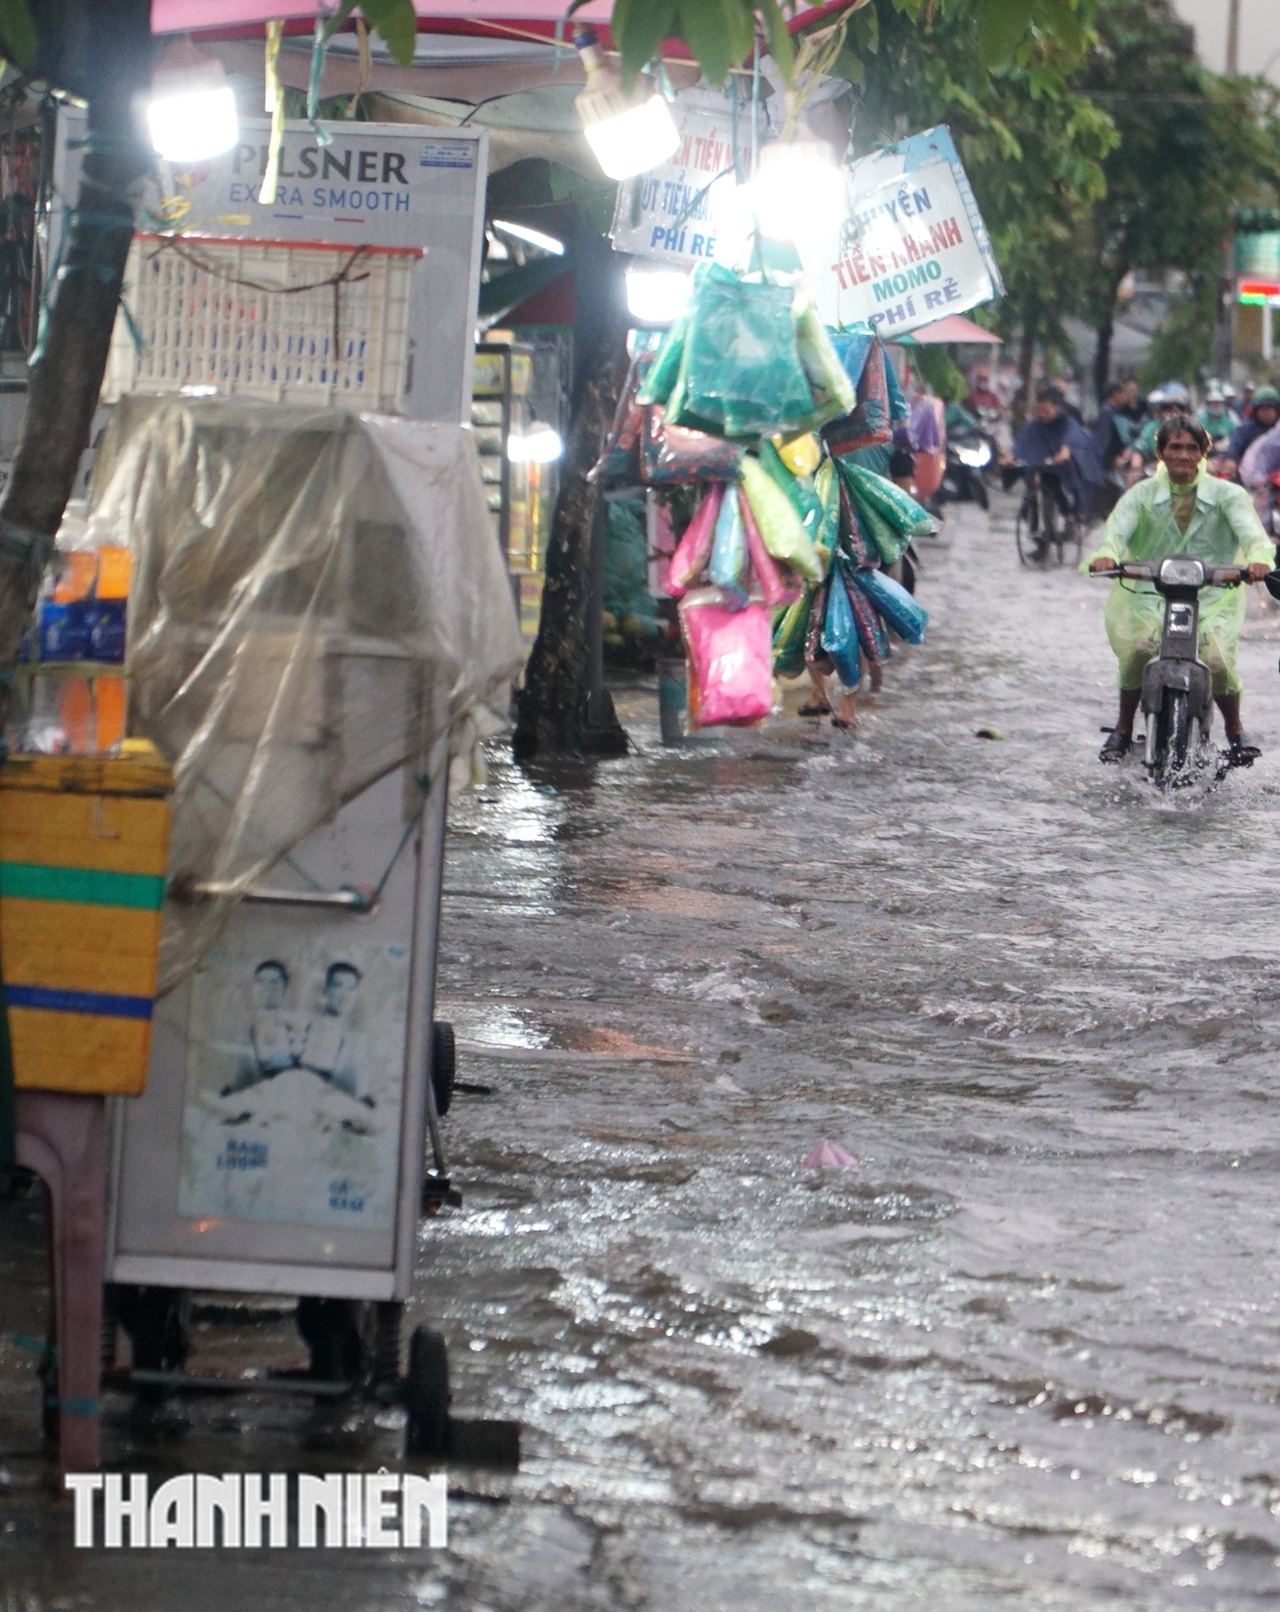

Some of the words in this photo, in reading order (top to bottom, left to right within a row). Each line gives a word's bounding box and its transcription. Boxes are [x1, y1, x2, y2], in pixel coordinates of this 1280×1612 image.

[231, 143, 409, 184] PILSNER
[230, 182, 304, 206] EXRA
[312, 187, 410, 212] SMOOTH
[650, 225, 688, 253] PHÍ
[690, 229, 717, 258] RẺ
[872, 259, 942, 303] MOMO
[867, 295, 917, 327] PHÍ
[923, 277, 962, 310] RẺ
